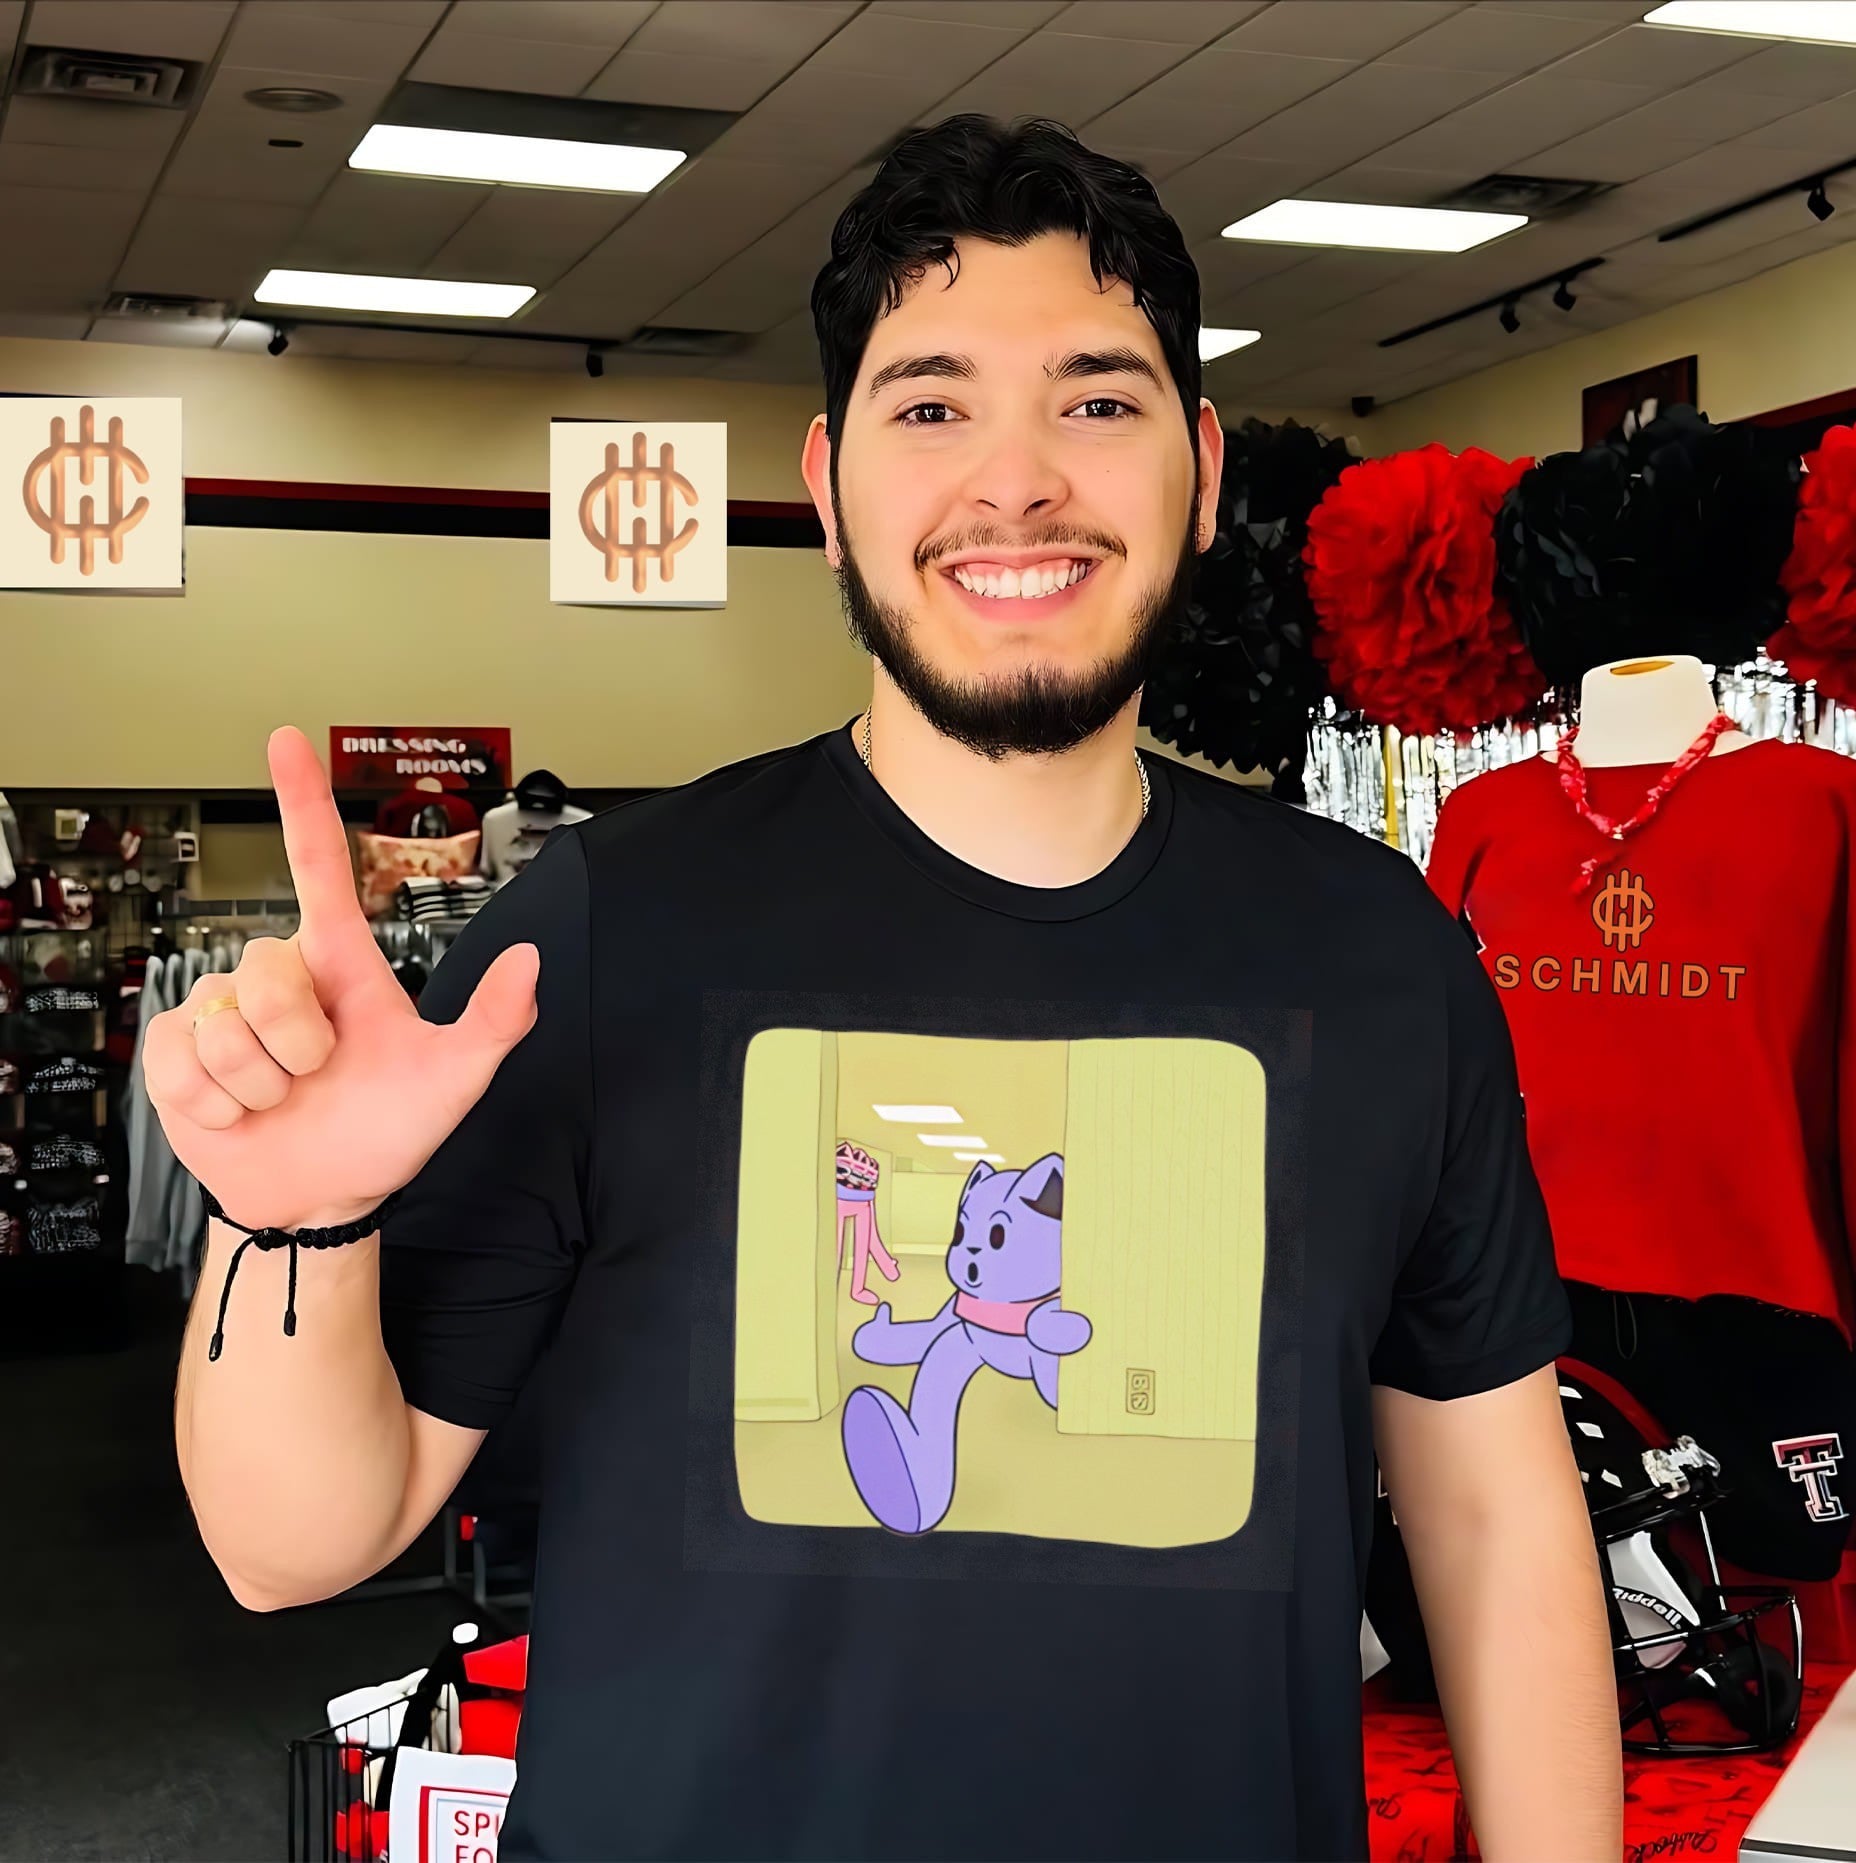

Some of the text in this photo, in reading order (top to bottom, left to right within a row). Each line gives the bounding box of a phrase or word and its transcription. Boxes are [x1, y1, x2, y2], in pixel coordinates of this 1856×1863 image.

[341, 737, 467, 754] DRESSING
[396, 758, 487, 775] ROOMS
[1493, 954, 1747, 1001] SCHMIDT
[1612, 1587, 1683, 1626] Riddell
